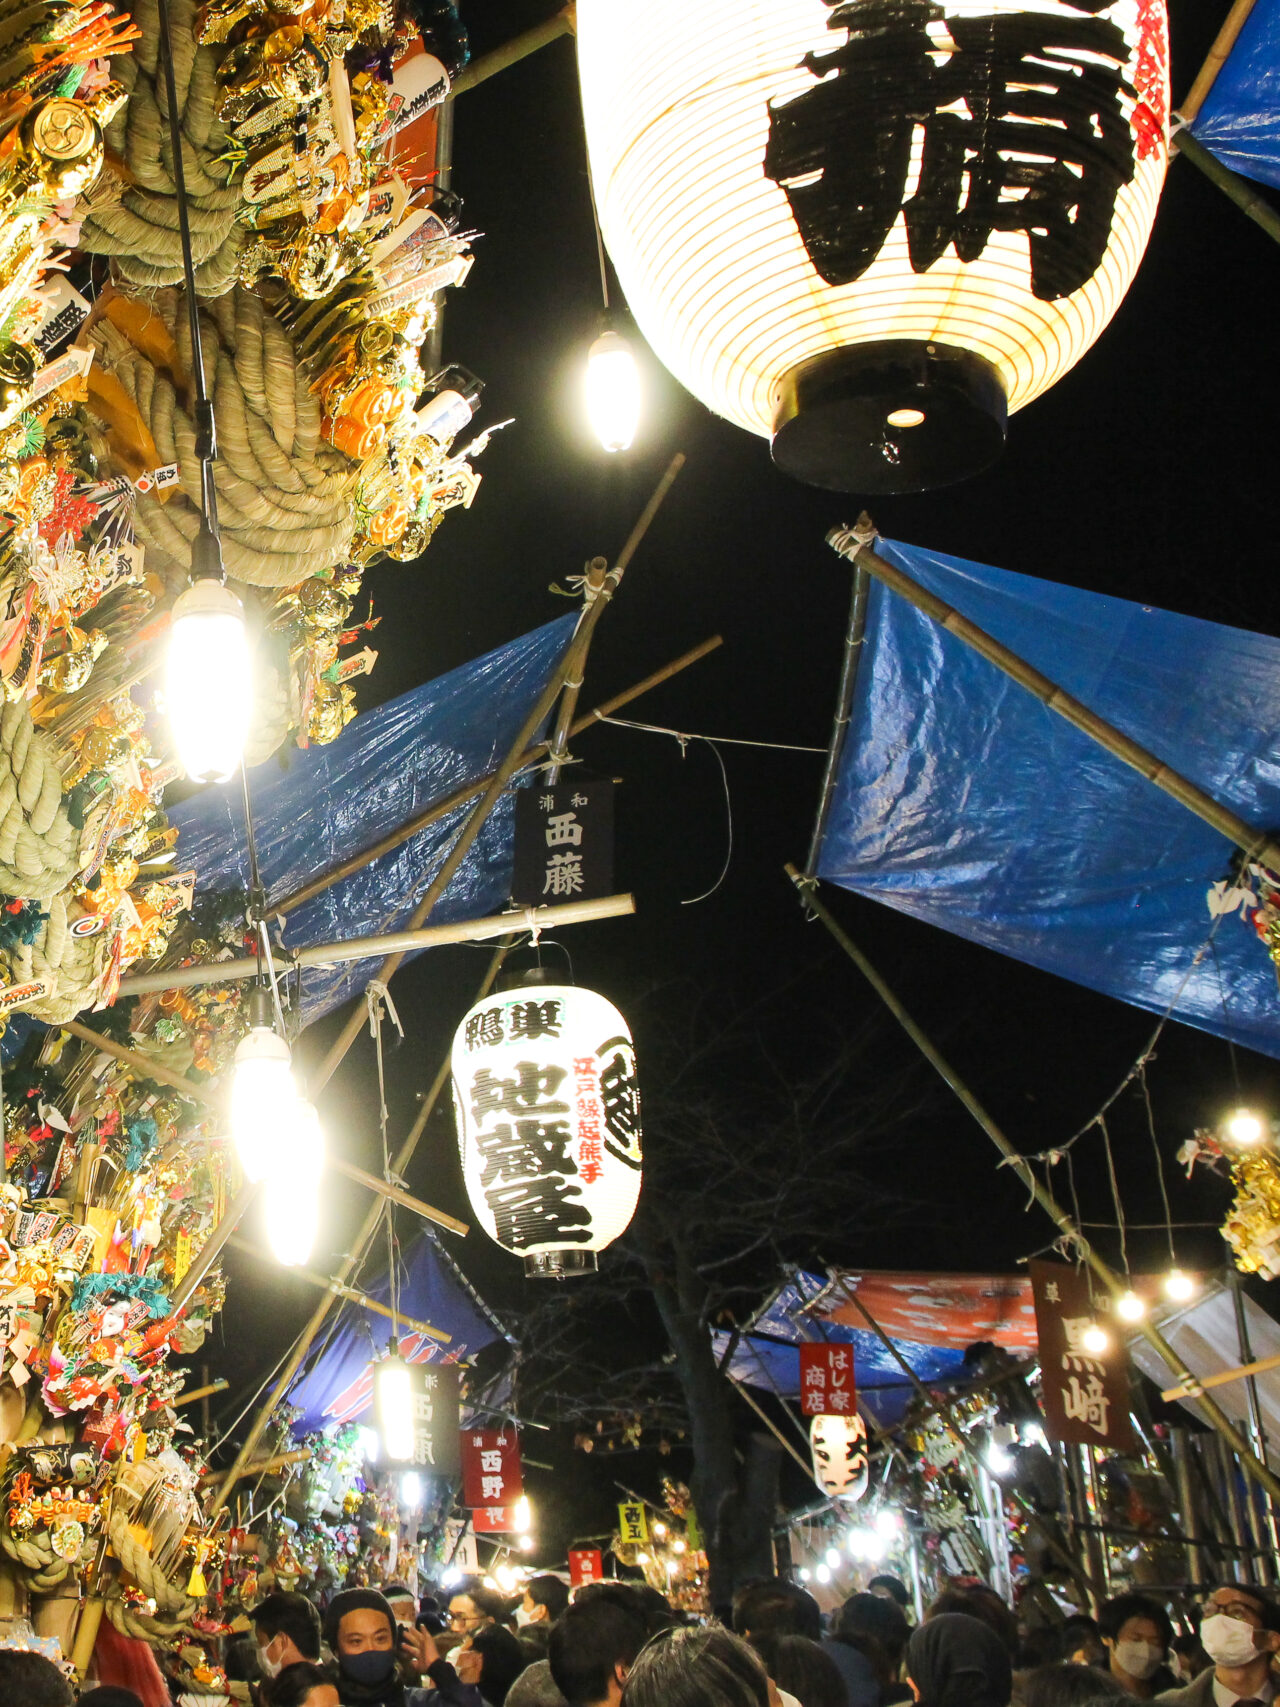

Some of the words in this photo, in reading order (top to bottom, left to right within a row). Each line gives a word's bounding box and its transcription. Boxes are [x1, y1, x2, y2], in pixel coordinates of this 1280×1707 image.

[538, 793, 588, 811] 浦和
[542, 814, 586, 896] 西藤
[470, 1060, 593, 1249] 地蔵屋
[805, 1364, 826, 1412] 商店
[828, 1349, 849, 1411] はし家
[480, 1450, 505, 1499] 西野
